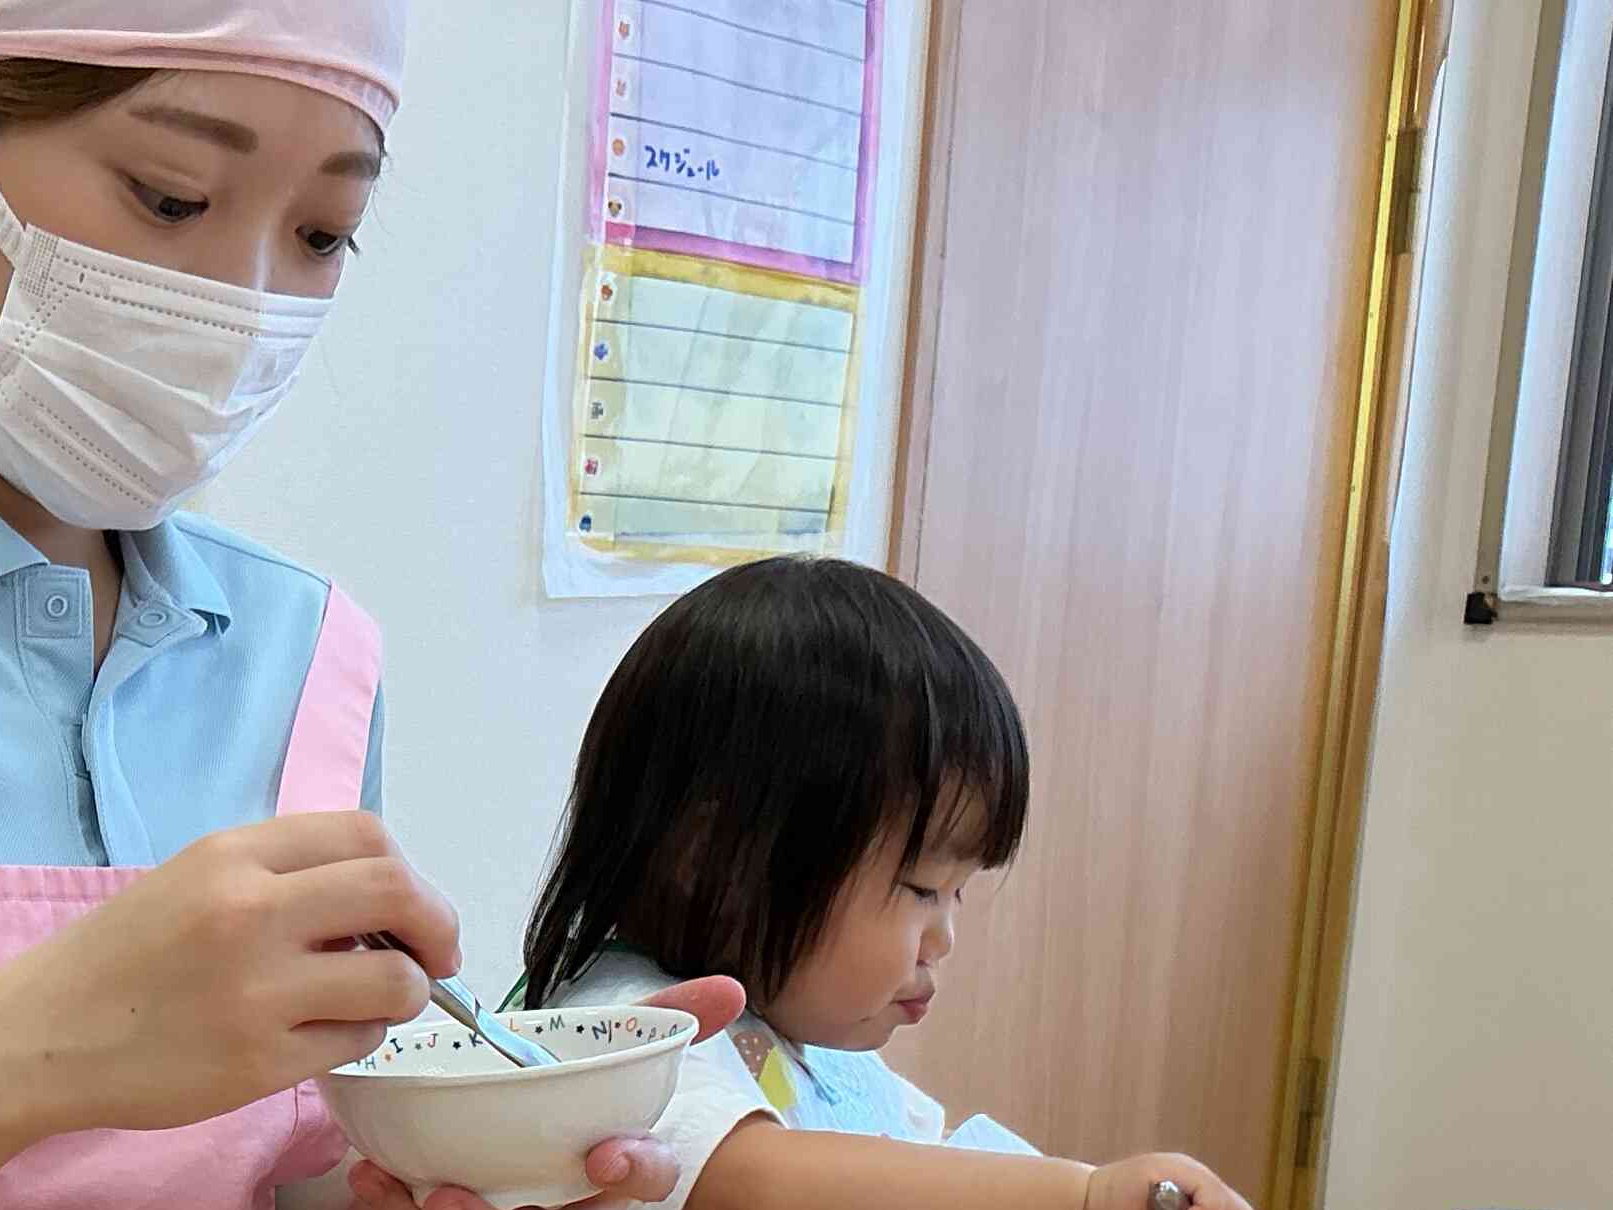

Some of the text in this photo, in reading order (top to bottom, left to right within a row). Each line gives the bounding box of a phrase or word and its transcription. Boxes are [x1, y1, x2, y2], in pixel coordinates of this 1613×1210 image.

[365, 1056, 376, 1070] H
[390, 1038, 403, 1053] I
[428, 1033, 438, 1048] J
[468, 1030, 483, 1048] K
[510, 1018, 520, 1032] L
[550, 1015, 565, 1031] M
[592, 1021, 607, 1039] N
[627, 1018, 638, 1033] O
